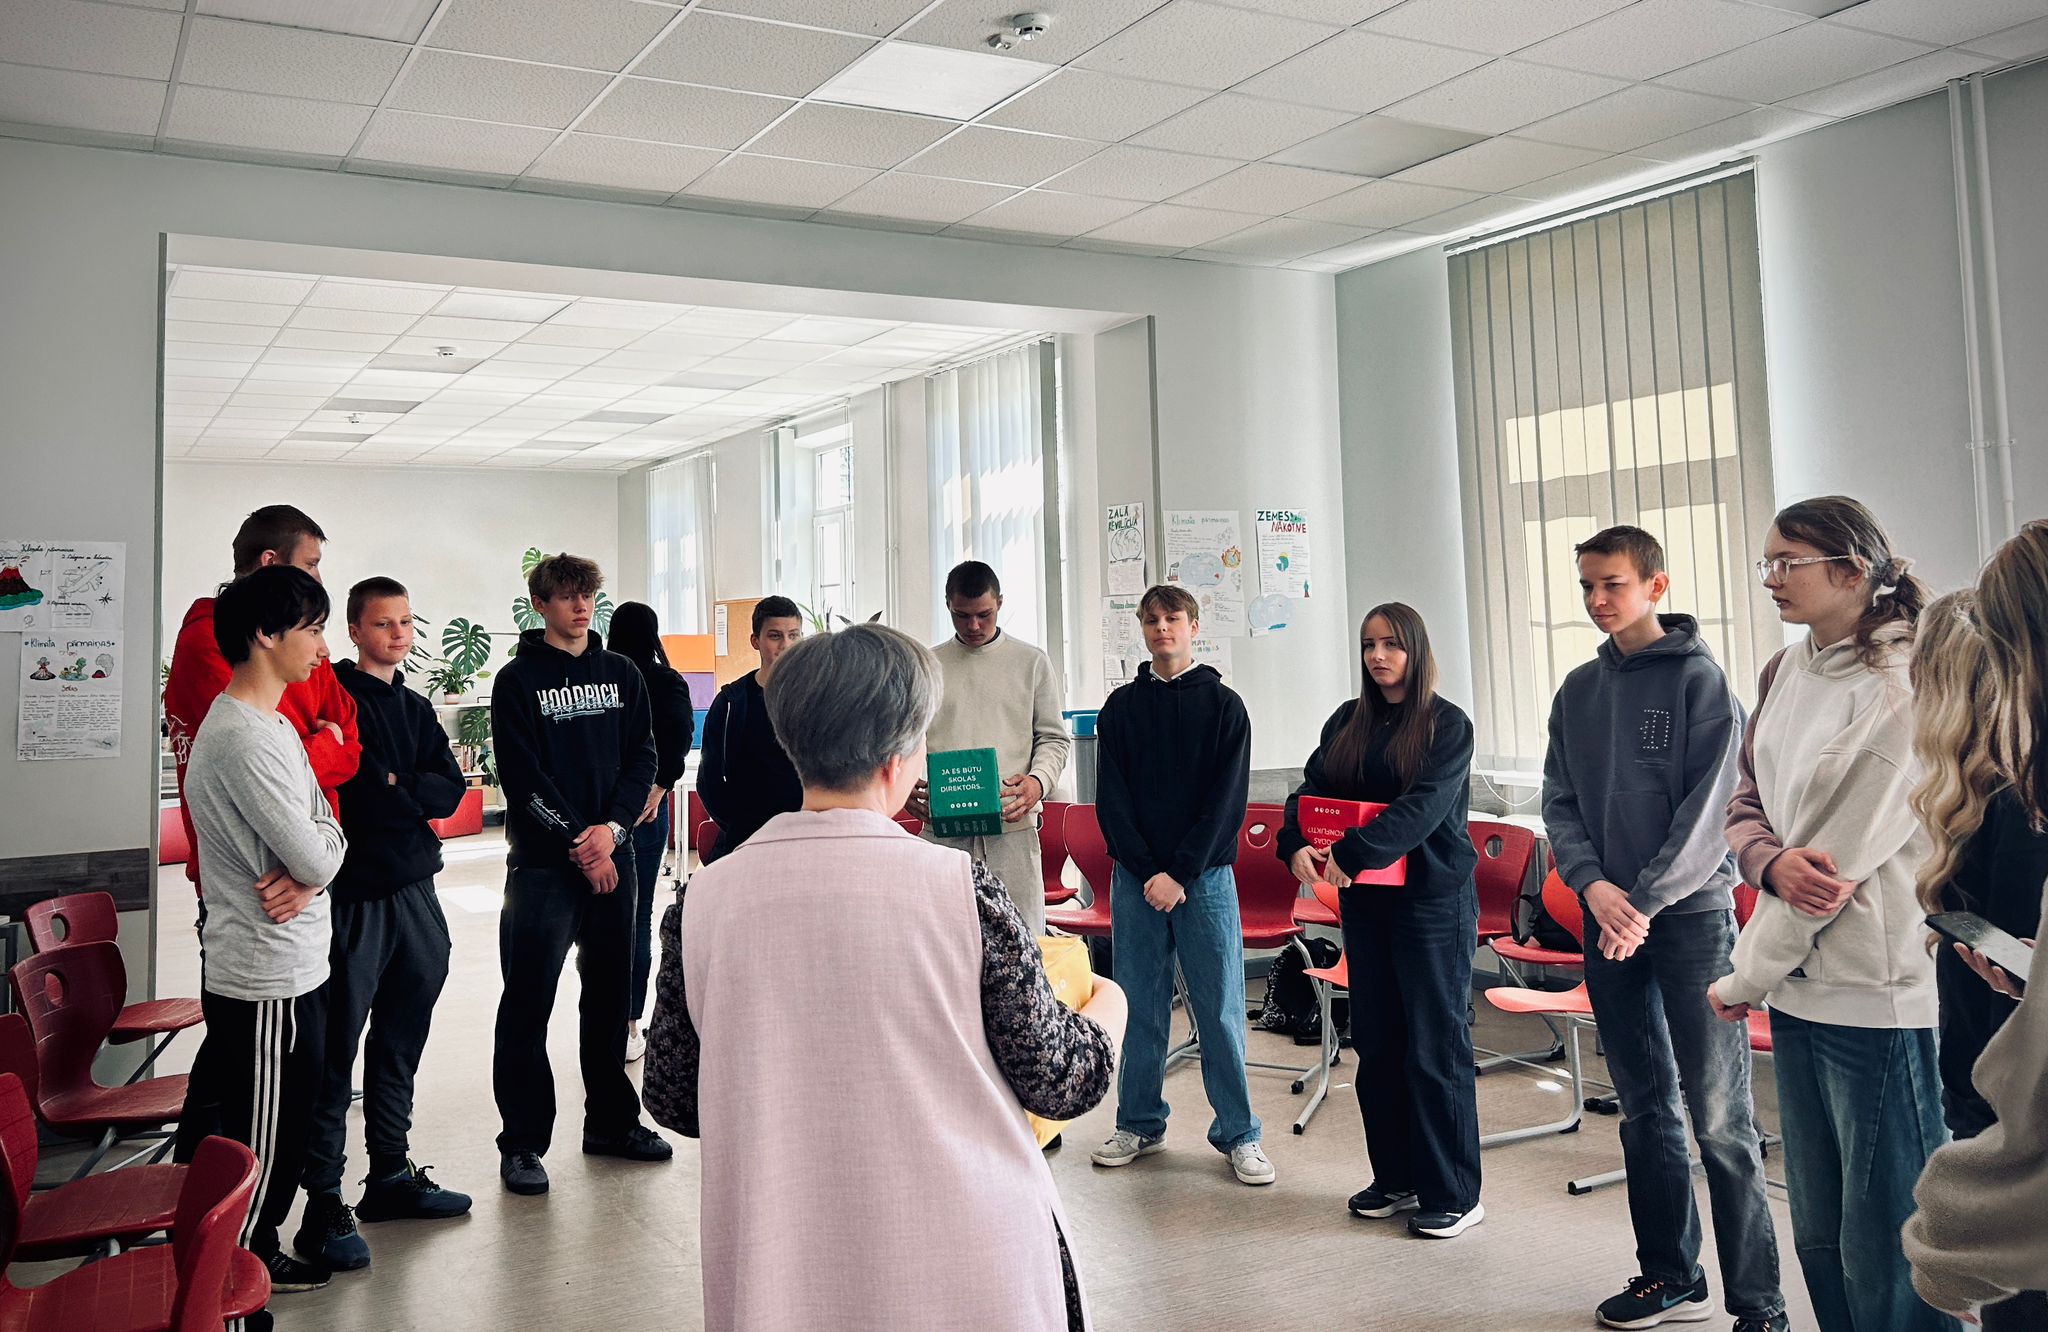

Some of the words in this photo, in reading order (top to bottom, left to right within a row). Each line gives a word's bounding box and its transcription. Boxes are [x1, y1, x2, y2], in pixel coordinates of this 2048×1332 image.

[1257, 510, 1290, 522] ZEMES
[30, 636, 56, 649] Klimata
[536, 683, 620, 712] HOODRICH
[962, 766, 982, 774] BŪTU
[948, 775, 977, 783] SKOLAS
